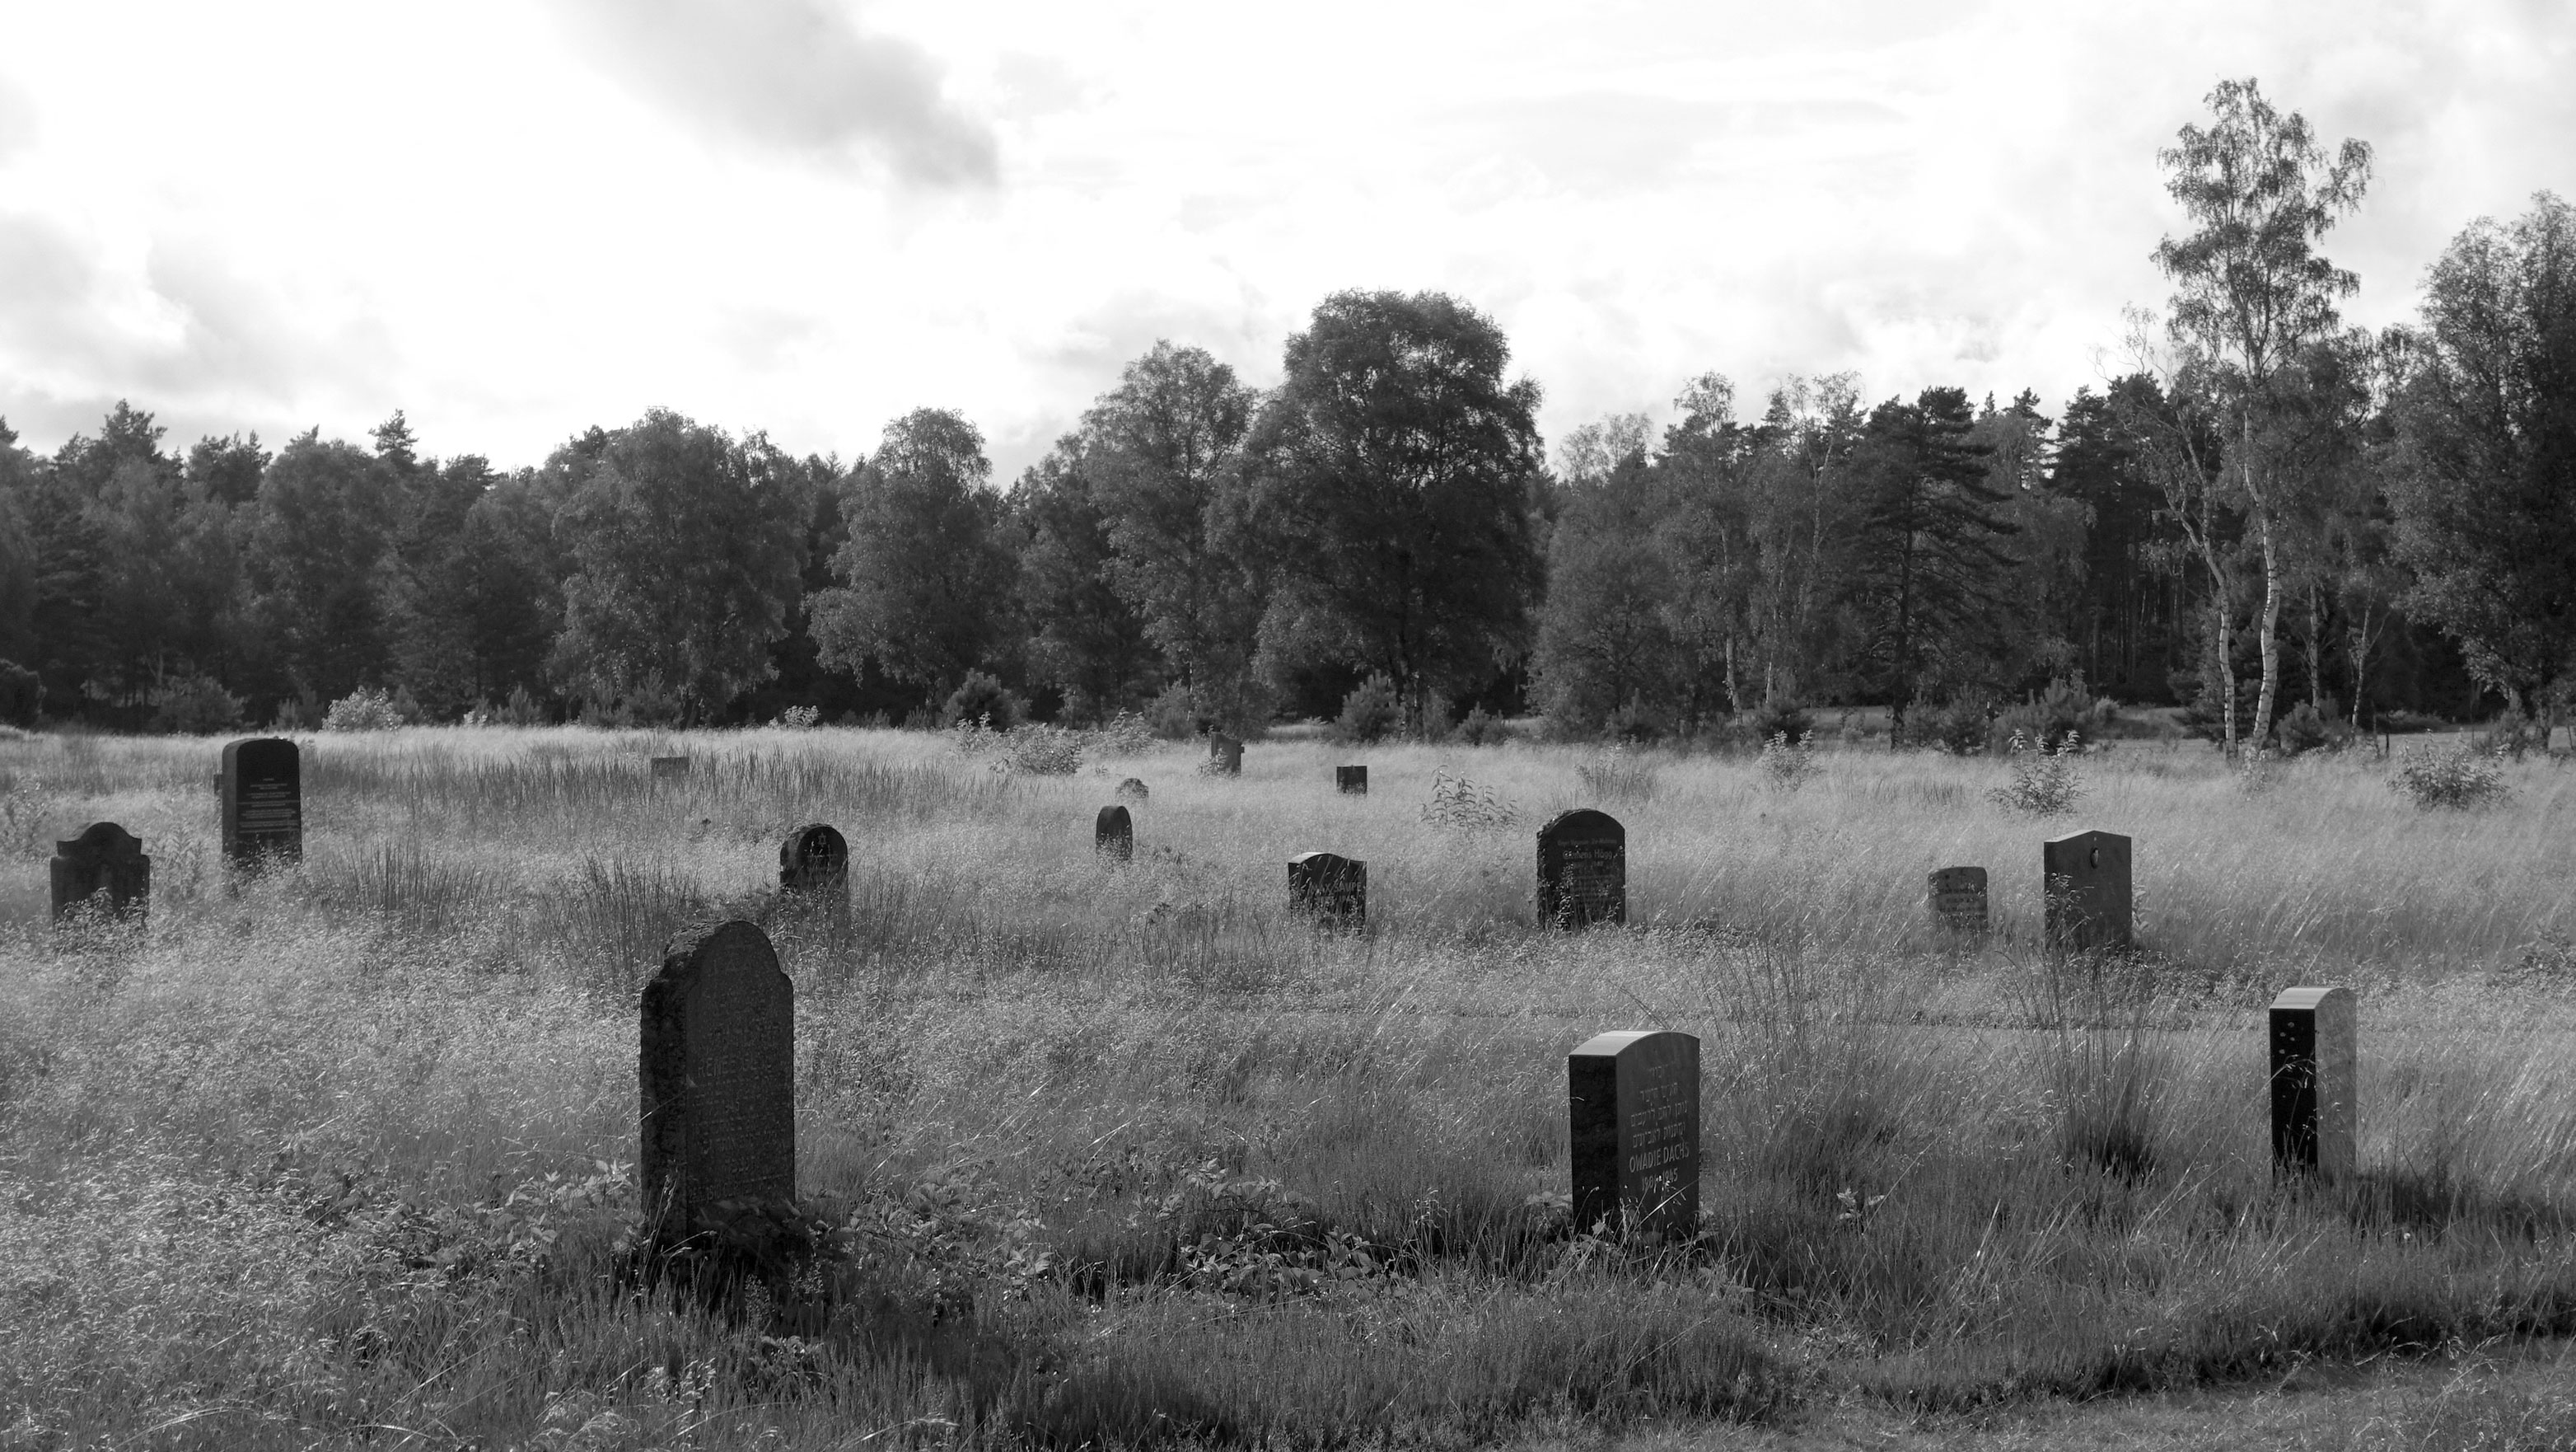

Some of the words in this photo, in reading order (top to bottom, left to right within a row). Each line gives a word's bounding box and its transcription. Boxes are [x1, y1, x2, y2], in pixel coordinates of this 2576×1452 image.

[1563, 849, 1592, 859] Cemens
[1594, 848, 1613, 860] Högg
[1629, 1148, 1662, 1173] OWADIE
[1663, 1141, 1690, 1164] DACHS
